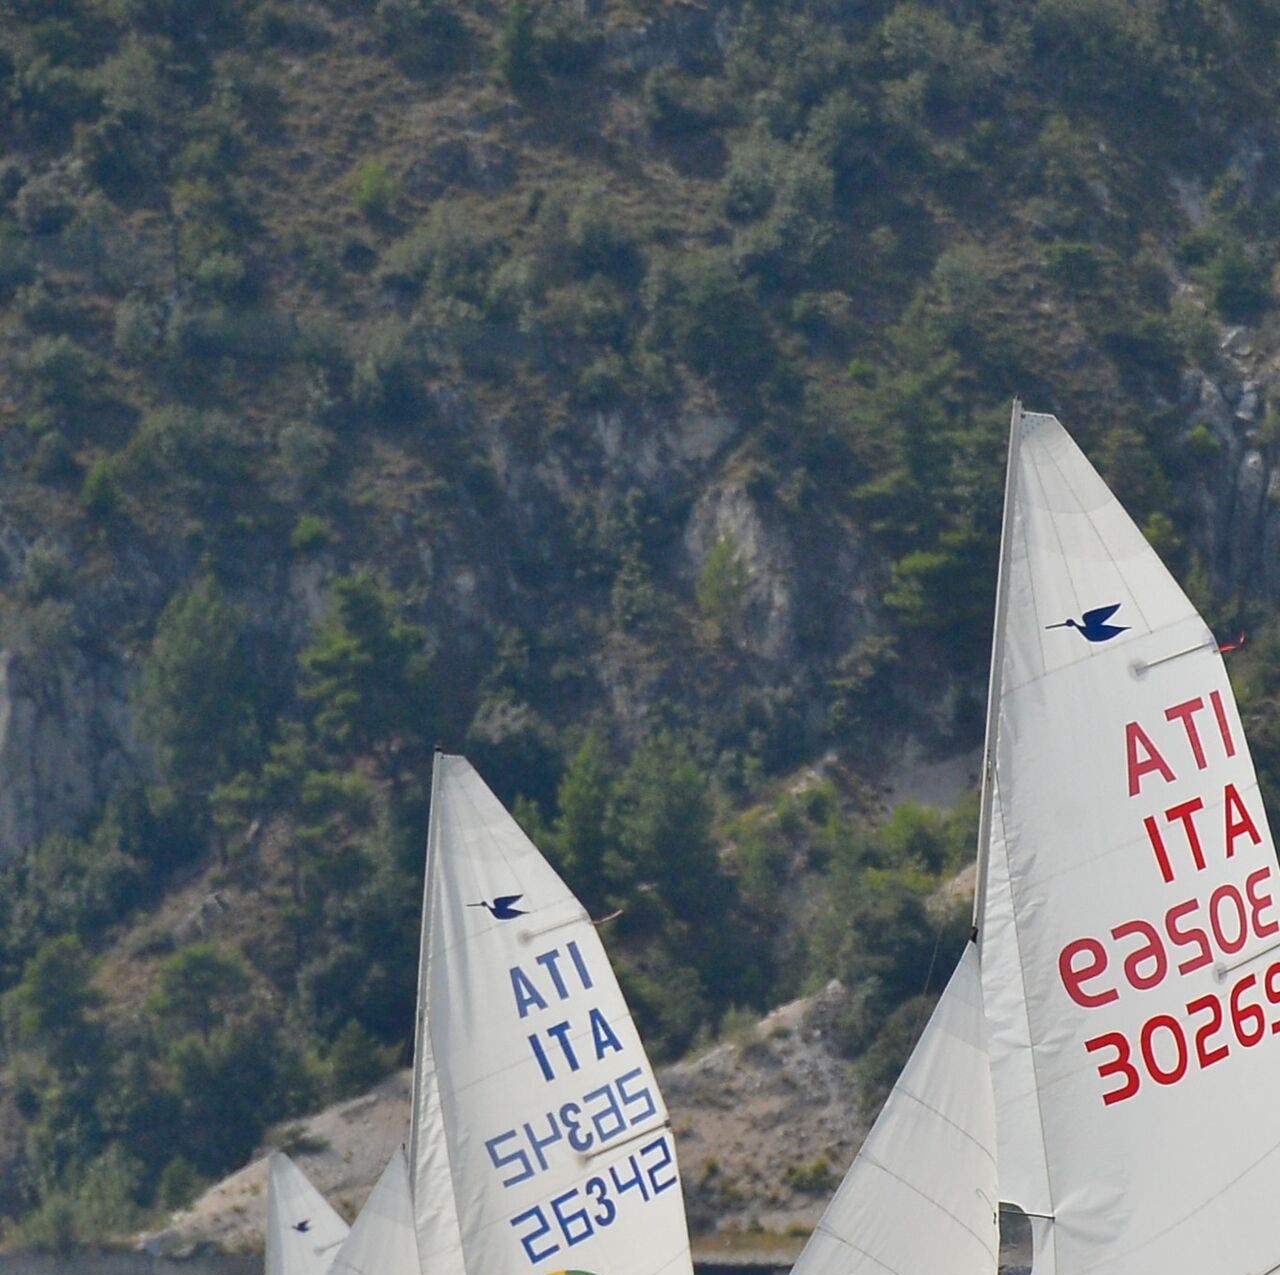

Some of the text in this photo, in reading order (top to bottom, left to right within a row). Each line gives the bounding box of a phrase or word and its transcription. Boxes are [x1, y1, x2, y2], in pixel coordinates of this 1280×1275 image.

[1143, 783, 1261, 883] ITA
[528, 1007, 623, 1082] ITA
[510, 1137, 677, 1264] 26342
